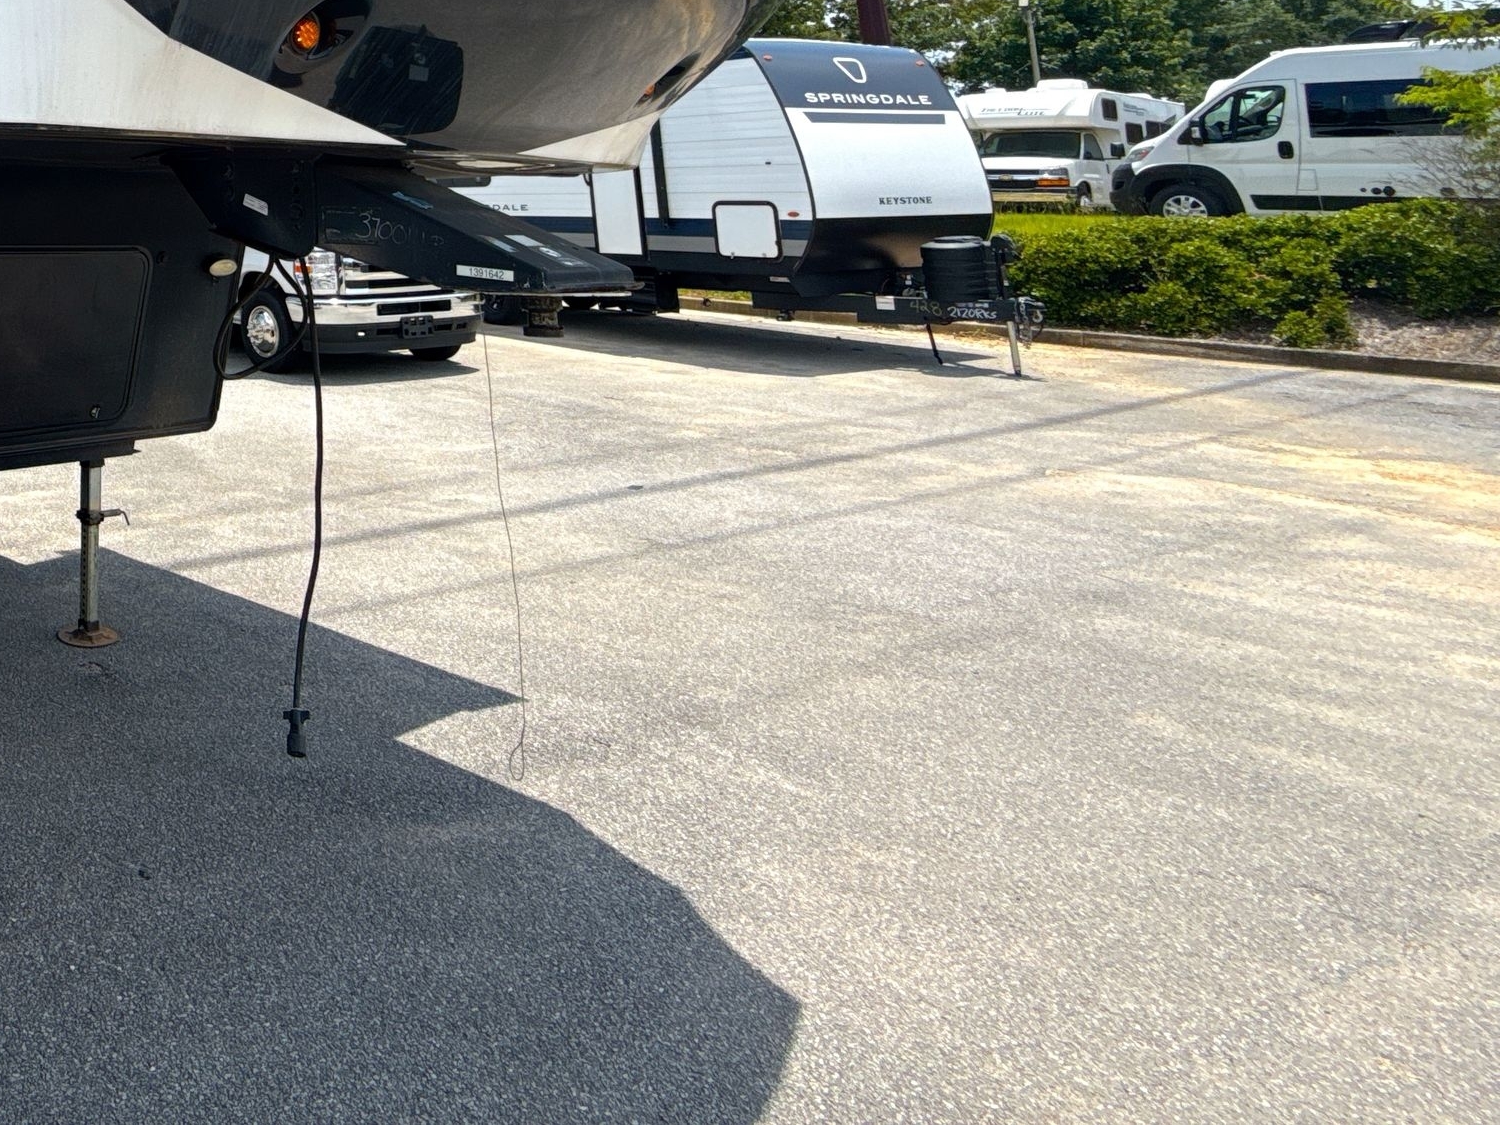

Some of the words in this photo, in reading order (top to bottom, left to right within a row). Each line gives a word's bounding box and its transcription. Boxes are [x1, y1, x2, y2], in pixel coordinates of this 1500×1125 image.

[804, 92, 932, 105] SPRINGDALE
[878, 196, 933, 205] KEYSTONE
[468, 267, 505, 280] 1391642
